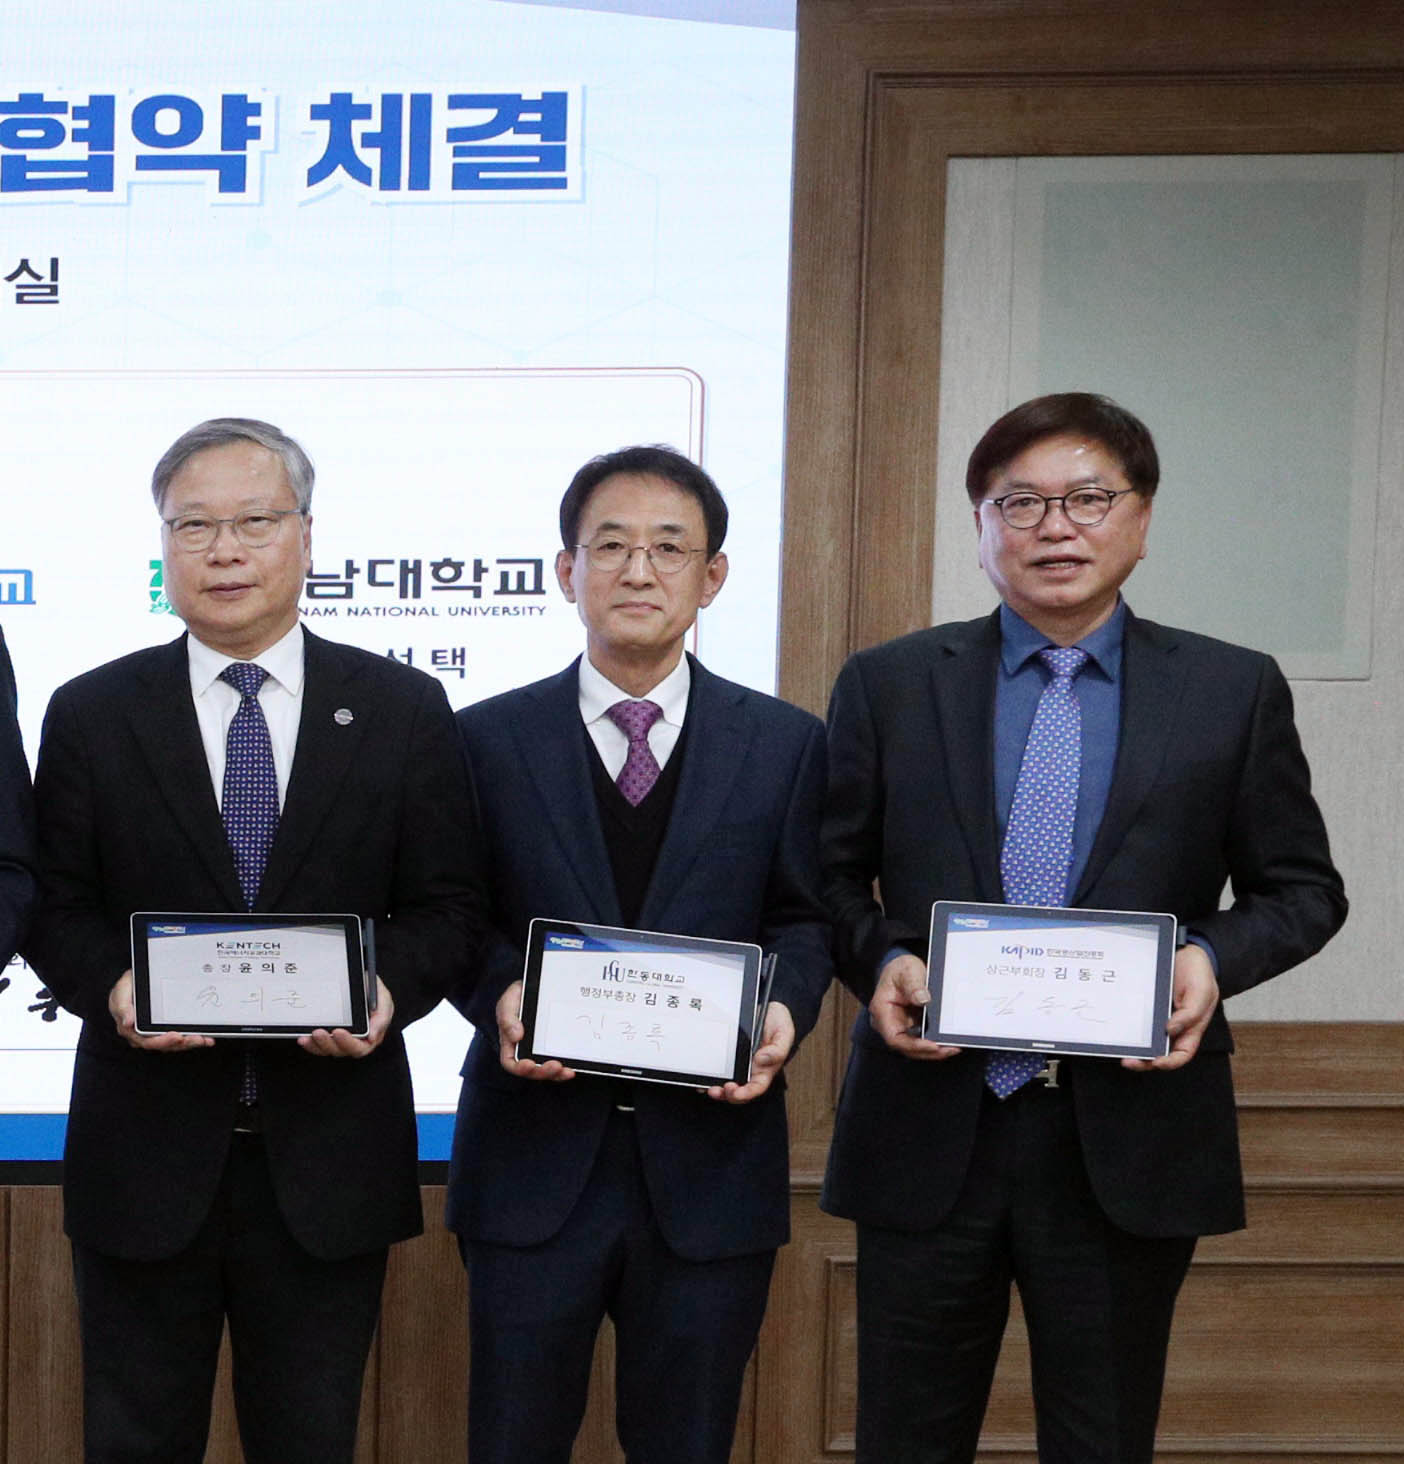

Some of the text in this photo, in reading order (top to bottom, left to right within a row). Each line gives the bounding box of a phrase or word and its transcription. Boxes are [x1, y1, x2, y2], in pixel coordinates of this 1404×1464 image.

[308, 92, 568, 191] 체결
[346, 605, 440, 617] NATIONAL
[447, 605, 547, 617] UNIVERSITY
